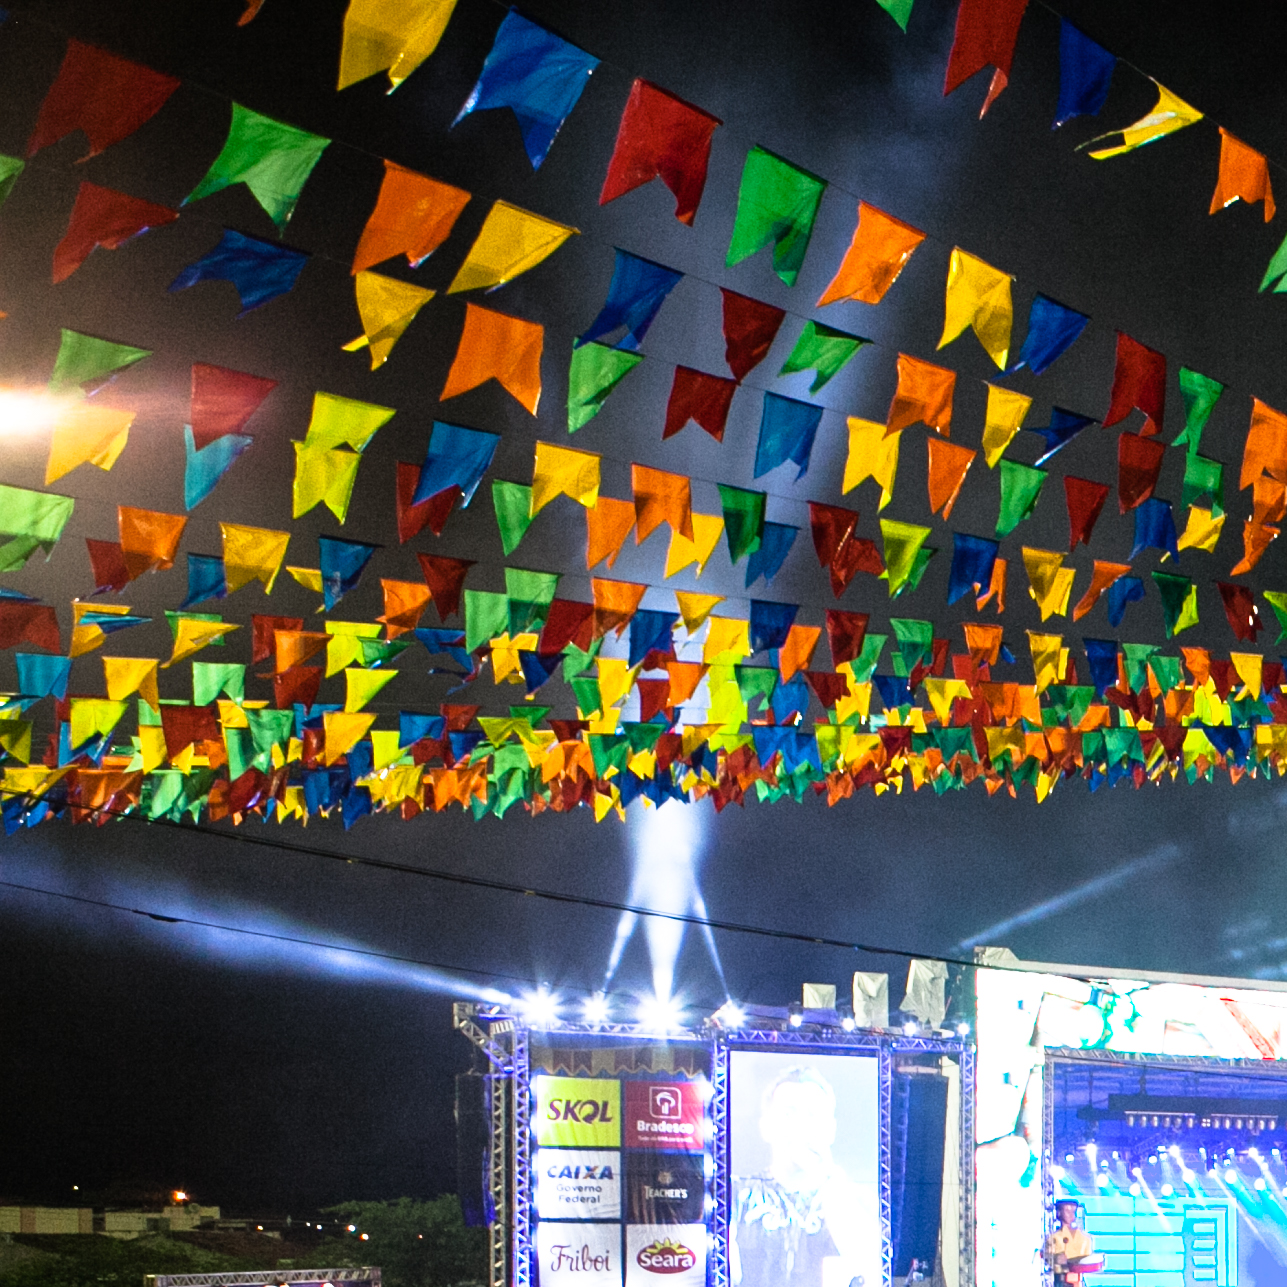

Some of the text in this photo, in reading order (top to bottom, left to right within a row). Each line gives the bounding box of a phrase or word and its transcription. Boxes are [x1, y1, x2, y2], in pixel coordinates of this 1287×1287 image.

[547, 1098, 613, 1125] SKOL
[636, 1119, 695, 1134] Bradesco
[547, 1165, 614, 1180] CAIXA
[556, 1183, 603, 1193] Governo
[558, 1194, 601, 1204] Federal
[550, 1243, 612, 1272] Friboi
[639, 1251, 694, 1268] Seara
